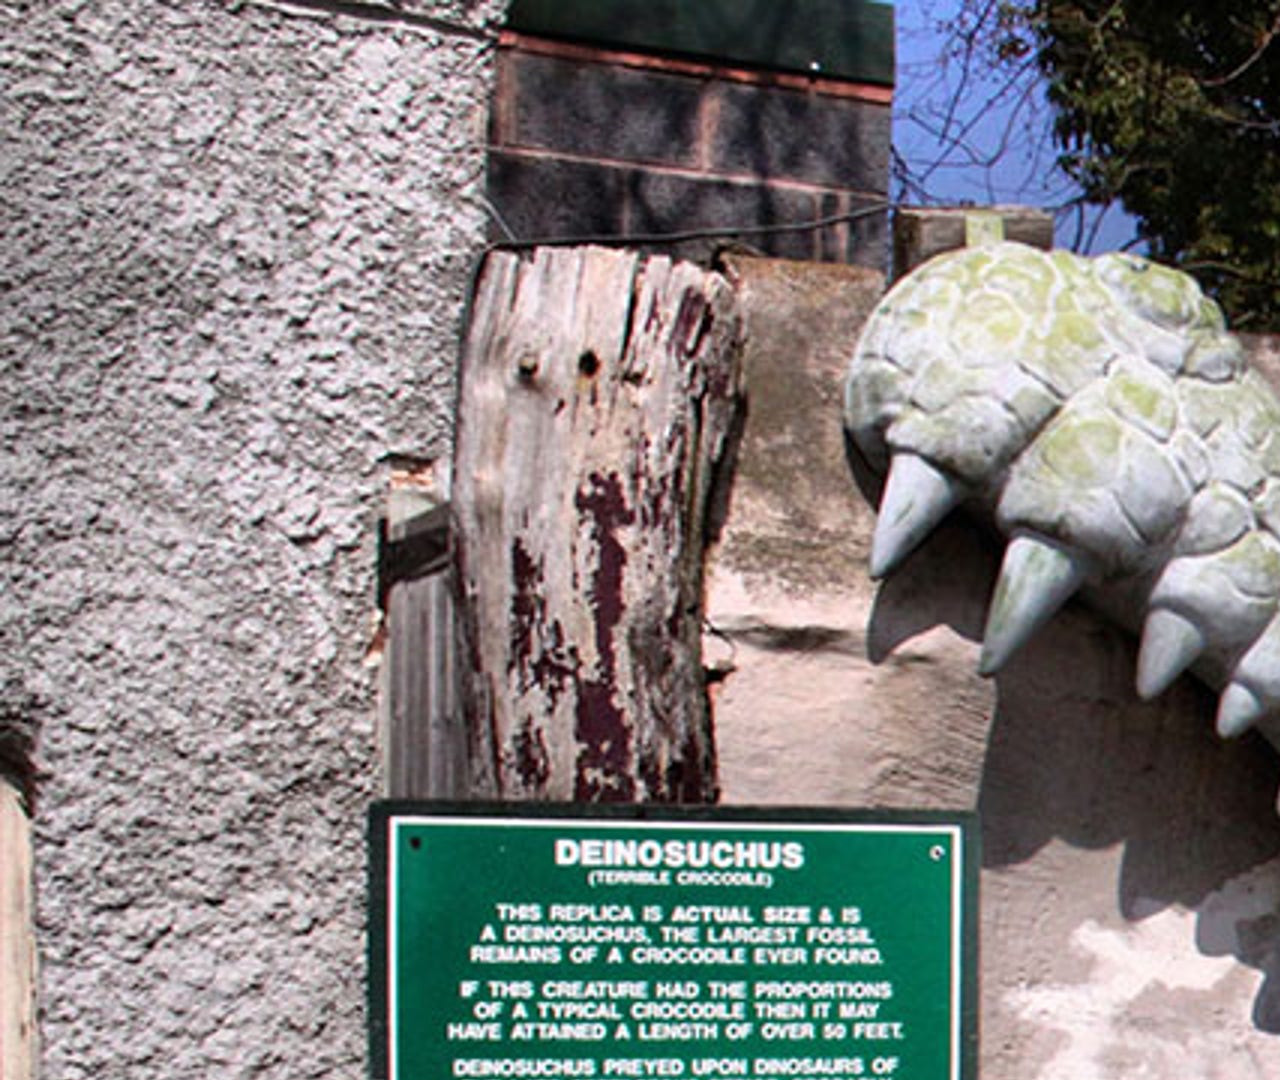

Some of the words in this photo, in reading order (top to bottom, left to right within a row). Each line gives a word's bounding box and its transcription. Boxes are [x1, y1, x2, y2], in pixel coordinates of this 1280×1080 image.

[555, 839, 803, 868] DEINOSUCHUS
[588, 870, 669, 885] (TERRIBLE
[676, 871, 772, 887] CROCODILE)
[497, 904, 541, 921] THIS
[550, 905, 633, 922] REPLICA
[643, 906, 662, 922] IS
[671, 906, 753, 923] ACTUAL
[763, 907, 810, 923] SIZE
[819, 908, 832, 923] &
[842, 908, 860, 924] IS
[480, 925, 496, 941] A
[504, 925, 651, 944] DEINOSUCHUS,
[661, 926, 698, 943] THE
[707, 927, 797, 943] LARGEST
[807, 927, 874, 944] FOSSIL
[470, 945, 561, 963] REMAINS
[569, 946, 597, 963] OF
[607, 947, 622, 963] A
[631, 947, 744, 964] CROCODILE
[754, 948, 806, 964] EVER
[814, 948, 882, 964] FOUND.
[460, 981, 478, 997] IF
[488, 981, 533, 998] THIS
[542, 981, 646, 998] CREATURE
[656, 982, 699, 999] HAD
[708, 982, 745, 999] THE
[754, 982, 891, 999] PROPORTIONS
[473, 1002, 501, 1019] OF
[512, 1003, 527, 1018] A
[538, 1002, 621, 1019] TYPICAL
[630, 1002, 744, 1019] CROCODILE
[754, 1002, 805, 1019] THEN
[812, 1002, 830, 1018] IT
[839, 1003, 879, 1018] MAY
[448, 1023, 500, 1040] HAVE
[511, 1023, 606, 1040] ATTAINED
[615, 1024, 630, 1039] A
[638, 1023, 717, 1040] LENGTH
[725, 1023, 752, 1040] OF
[761, 1023, 814, 1039] OVER
[823, 1023, 846, 1039] 50
[853, 1023, 902, 1039] FEET.
[453, 1059, 595, 1076] DEINOSUCHUS
[603, 1059, 684, 1076] PREYED
[691, 1059, 746, 1075] UPON
[754, 1058, 864, 1074] DINOSAURS
[872, 1057, 897, 1074] OF
